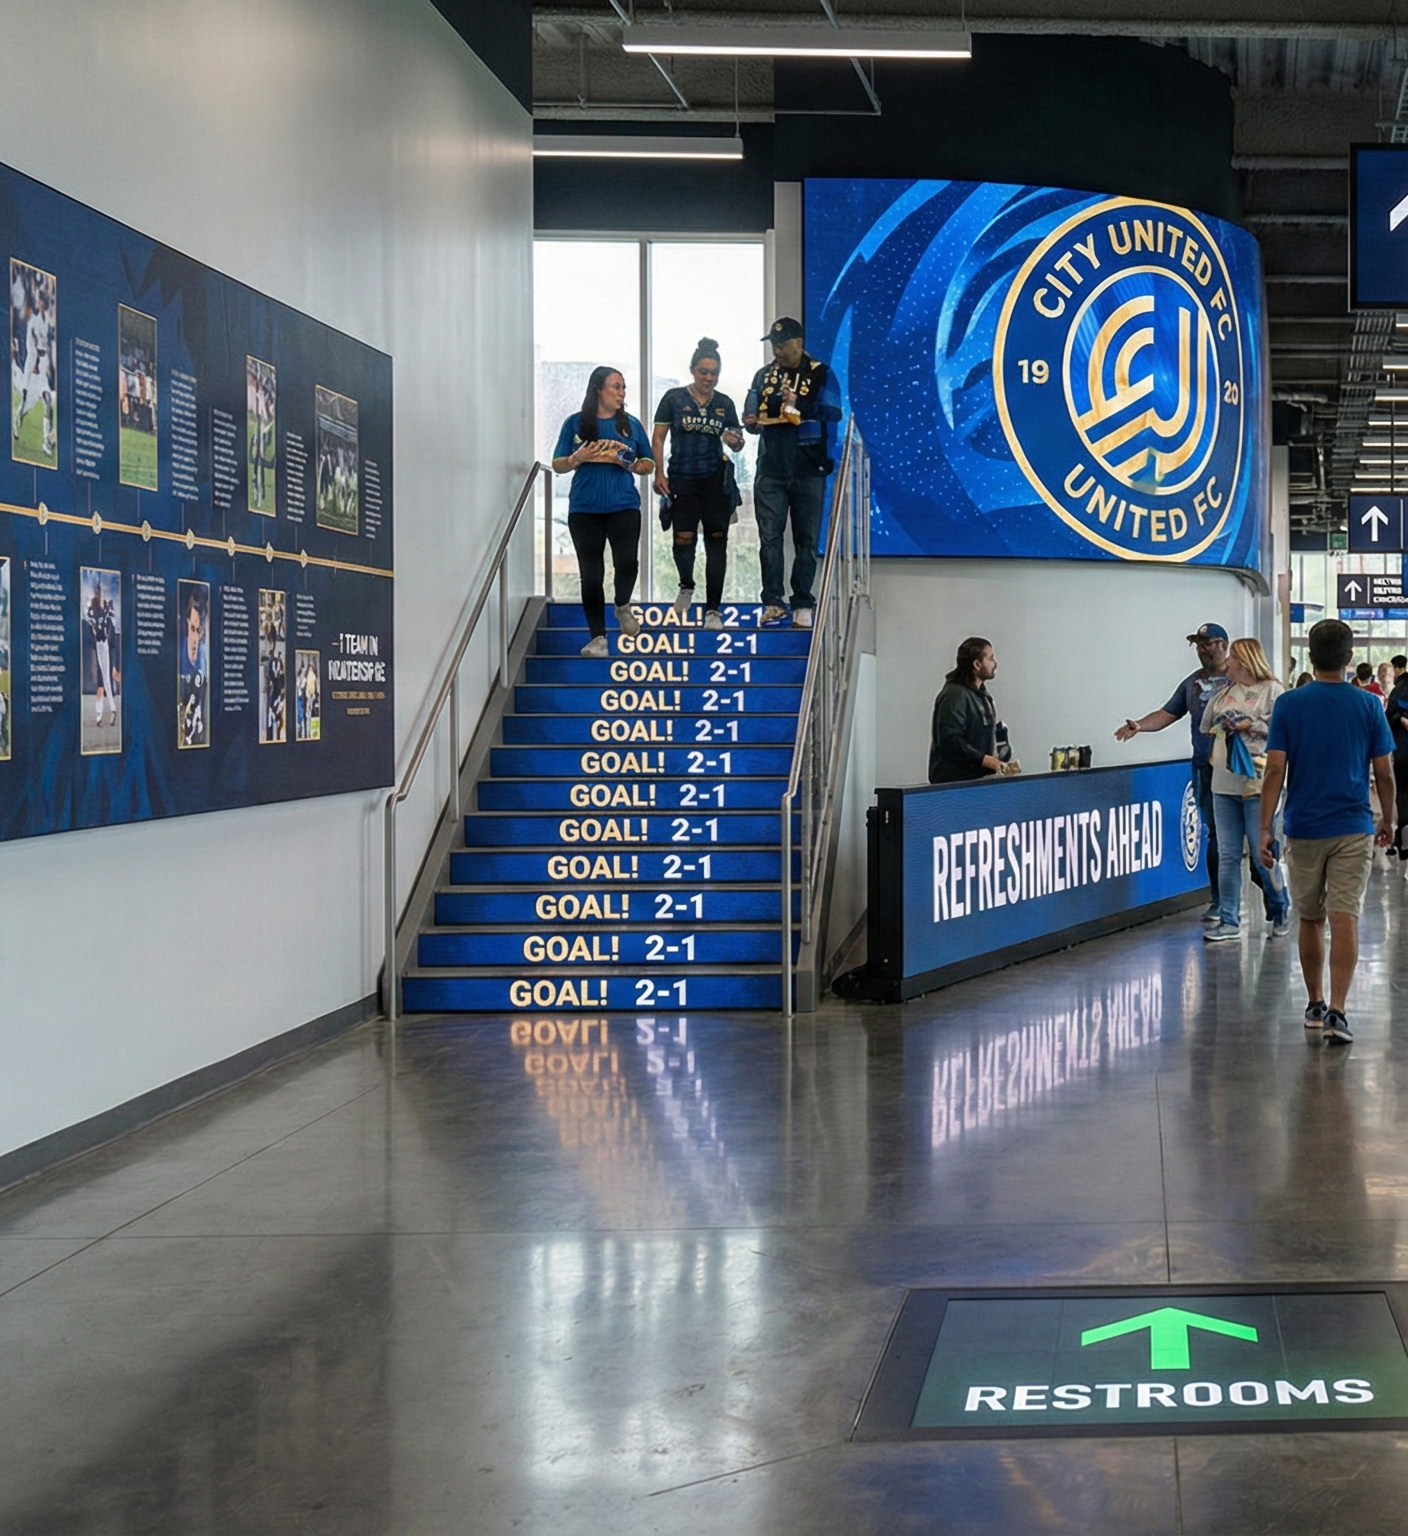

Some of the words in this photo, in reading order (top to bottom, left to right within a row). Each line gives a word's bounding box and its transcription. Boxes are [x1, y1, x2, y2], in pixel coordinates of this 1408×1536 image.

[1033, 233, 1101, 318] CITY
[1107, 219, 1212, 286] UNITED
[1210, 287, 1232, 341] FC
[1018, 359, 1049, 385] 19
[1223, 380, 1239, 405] 20
[1064, 463, 1188, 542] UNITED
[1193, 476, 1222, 526] FC
[723, 606, 763, 627] 2-1
[618, 633, 694, 653] GOAL!
[717, 633, 756, 654] 2-1
[611, 661, 688, 681] GOAL!
[711, 661, 750, 682] 2-1
[601, 690, 680, 710] GOAL!
[703, 690, 743, 711] 2-1
[592, 720, 673, 741] GOAL!
[696, 720, 737, 741] 2-1
[582, 752, 664, 773] GOAL!
[688, 751, 730, 773] 2-1
[571, 784, 655, 806] GOAL!
[680, 784, 724, 807] 2-1
[560, 819, 647, 841] GOAL!
[672, 818, 717, 841] 2-1
[548, 856, 638, 879] GOAL!
[664, 855, 710, 878] 2-1
[933, 809, 1102, 923] REFRESHMENTS
[1106, 800, 1163, 879] AHEAD
[536, 894, 628, 919] GOAL!
[655, 894, 702, 918] 2-1
[524, 936, 618, 961] GOAL!
[646, 935, 694, 960] 2-1
[510, 980, 607, 1006] GOAL!
[636, 980, 686, 1005] 2-1
[965, 1379, 1374, 1412] RESTROOMS
